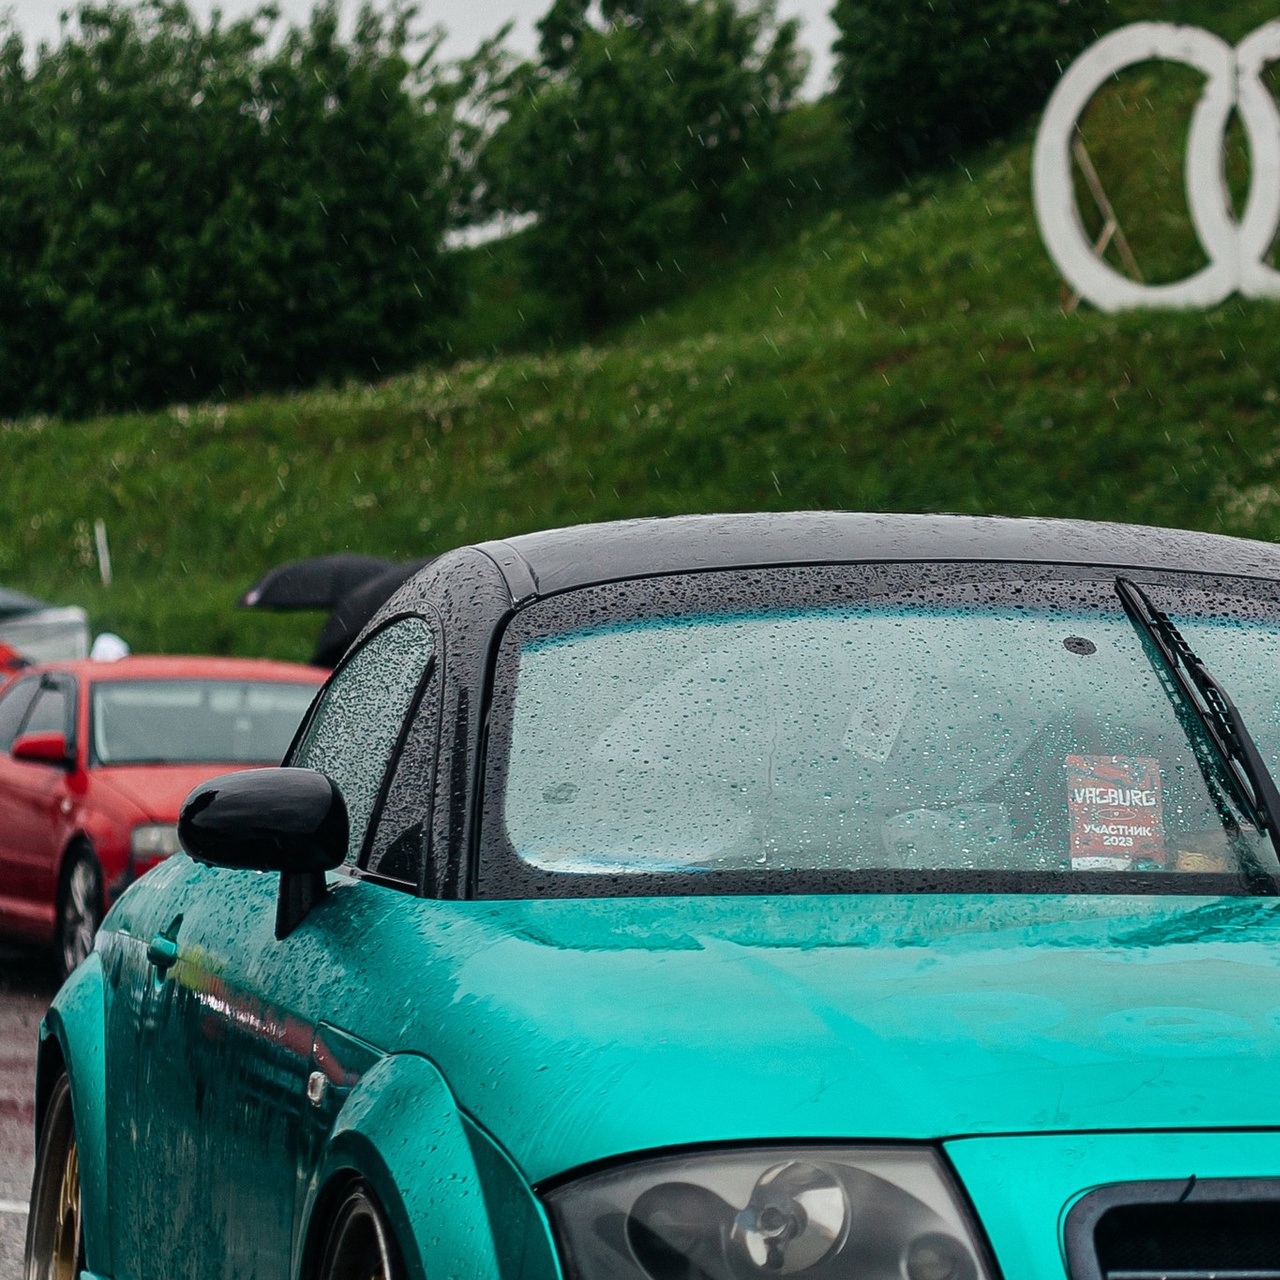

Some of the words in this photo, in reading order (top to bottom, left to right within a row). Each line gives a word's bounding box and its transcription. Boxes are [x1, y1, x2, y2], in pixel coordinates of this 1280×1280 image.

[1073, 787, 1157, 807] VAGBURG
[1082, 823, 1153, 837] УЧАСТНИК
[1103, 835, 1134, 847] 2023
